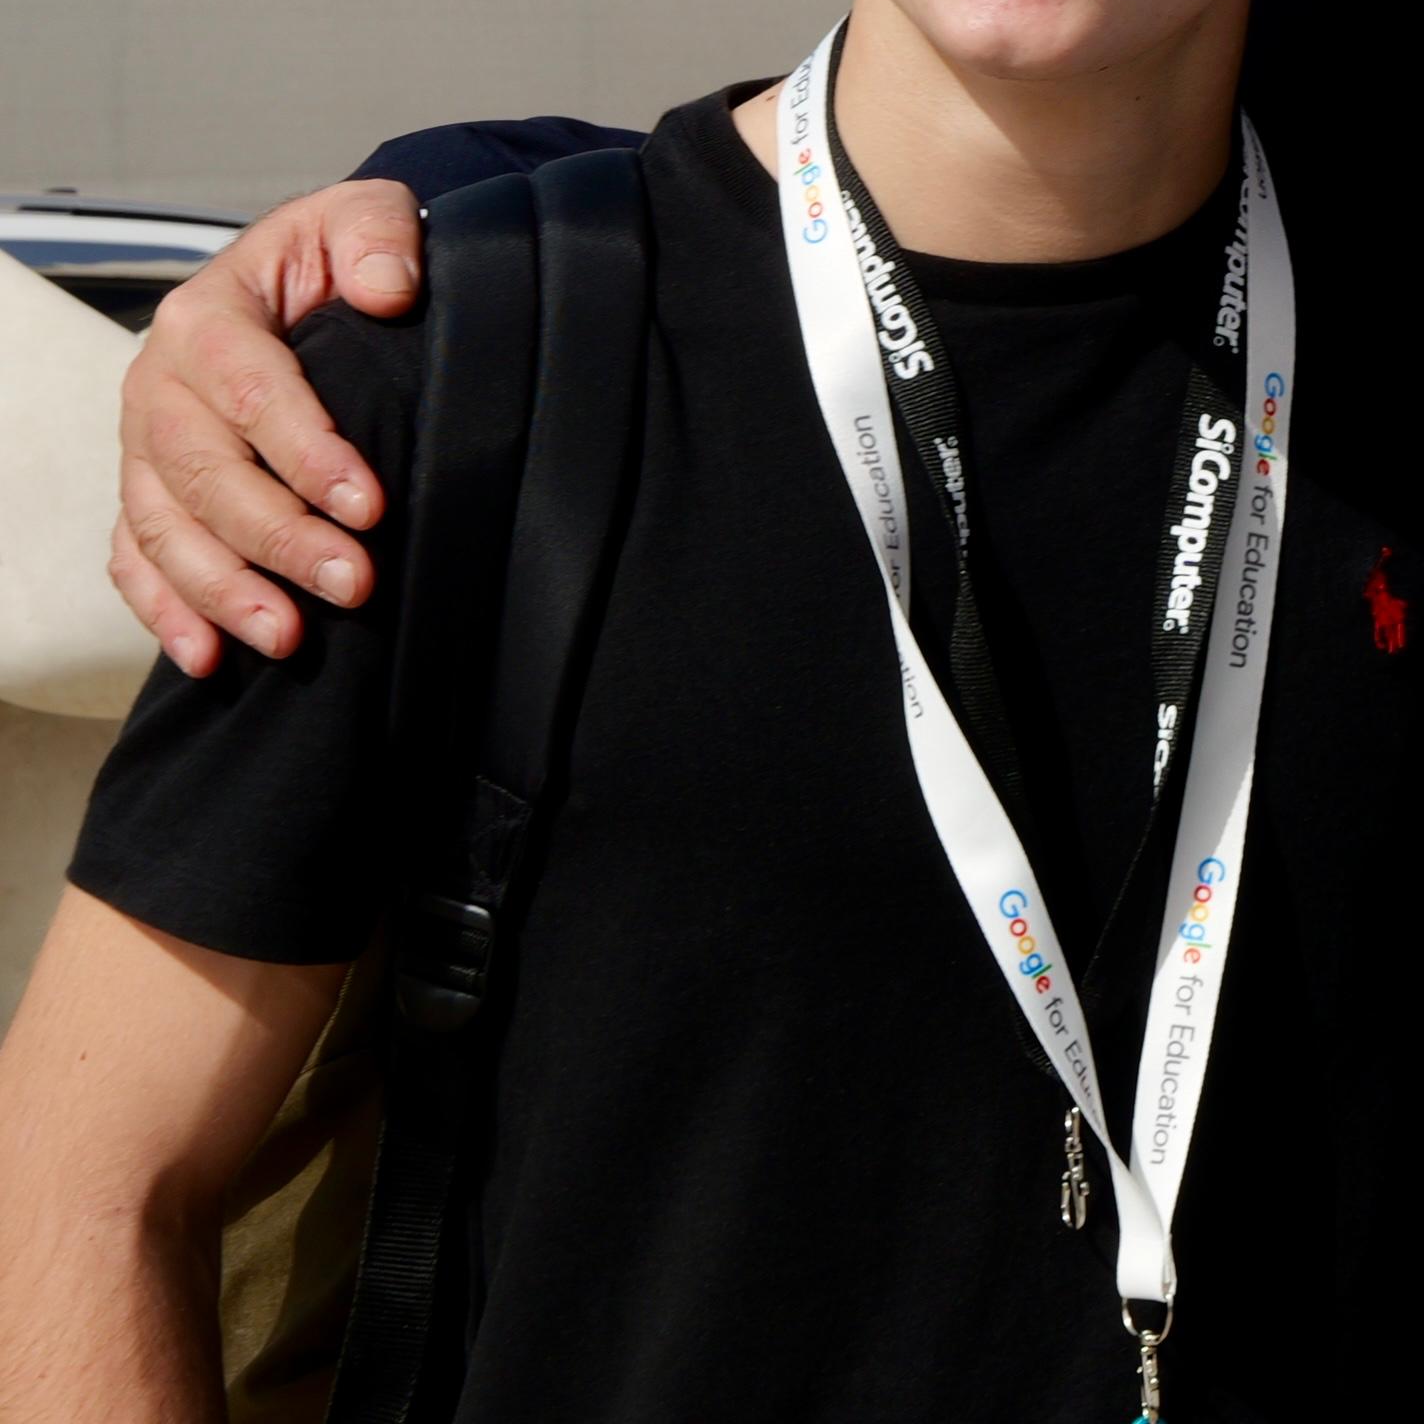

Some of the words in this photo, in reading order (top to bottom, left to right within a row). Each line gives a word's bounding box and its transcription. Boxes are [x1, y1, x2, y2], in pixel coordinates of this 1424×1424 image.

[791, 111, 809, 146] for
[793, 147, 828, 244] Google
[1253, 372, 1285, 476] Google
[853, 414, 901, 550] Education
[1251, 484, 1273, 525] for
[1229, 531, 1269, 668] Education
[999, 888, 1052, 994] Google
[1044, 995, 1069, 1036] for
[1179, 856, 1226, 964] Google
[1175, 973, 1204, 1016] for
[1150, 1022, 1195, 1166] Education
